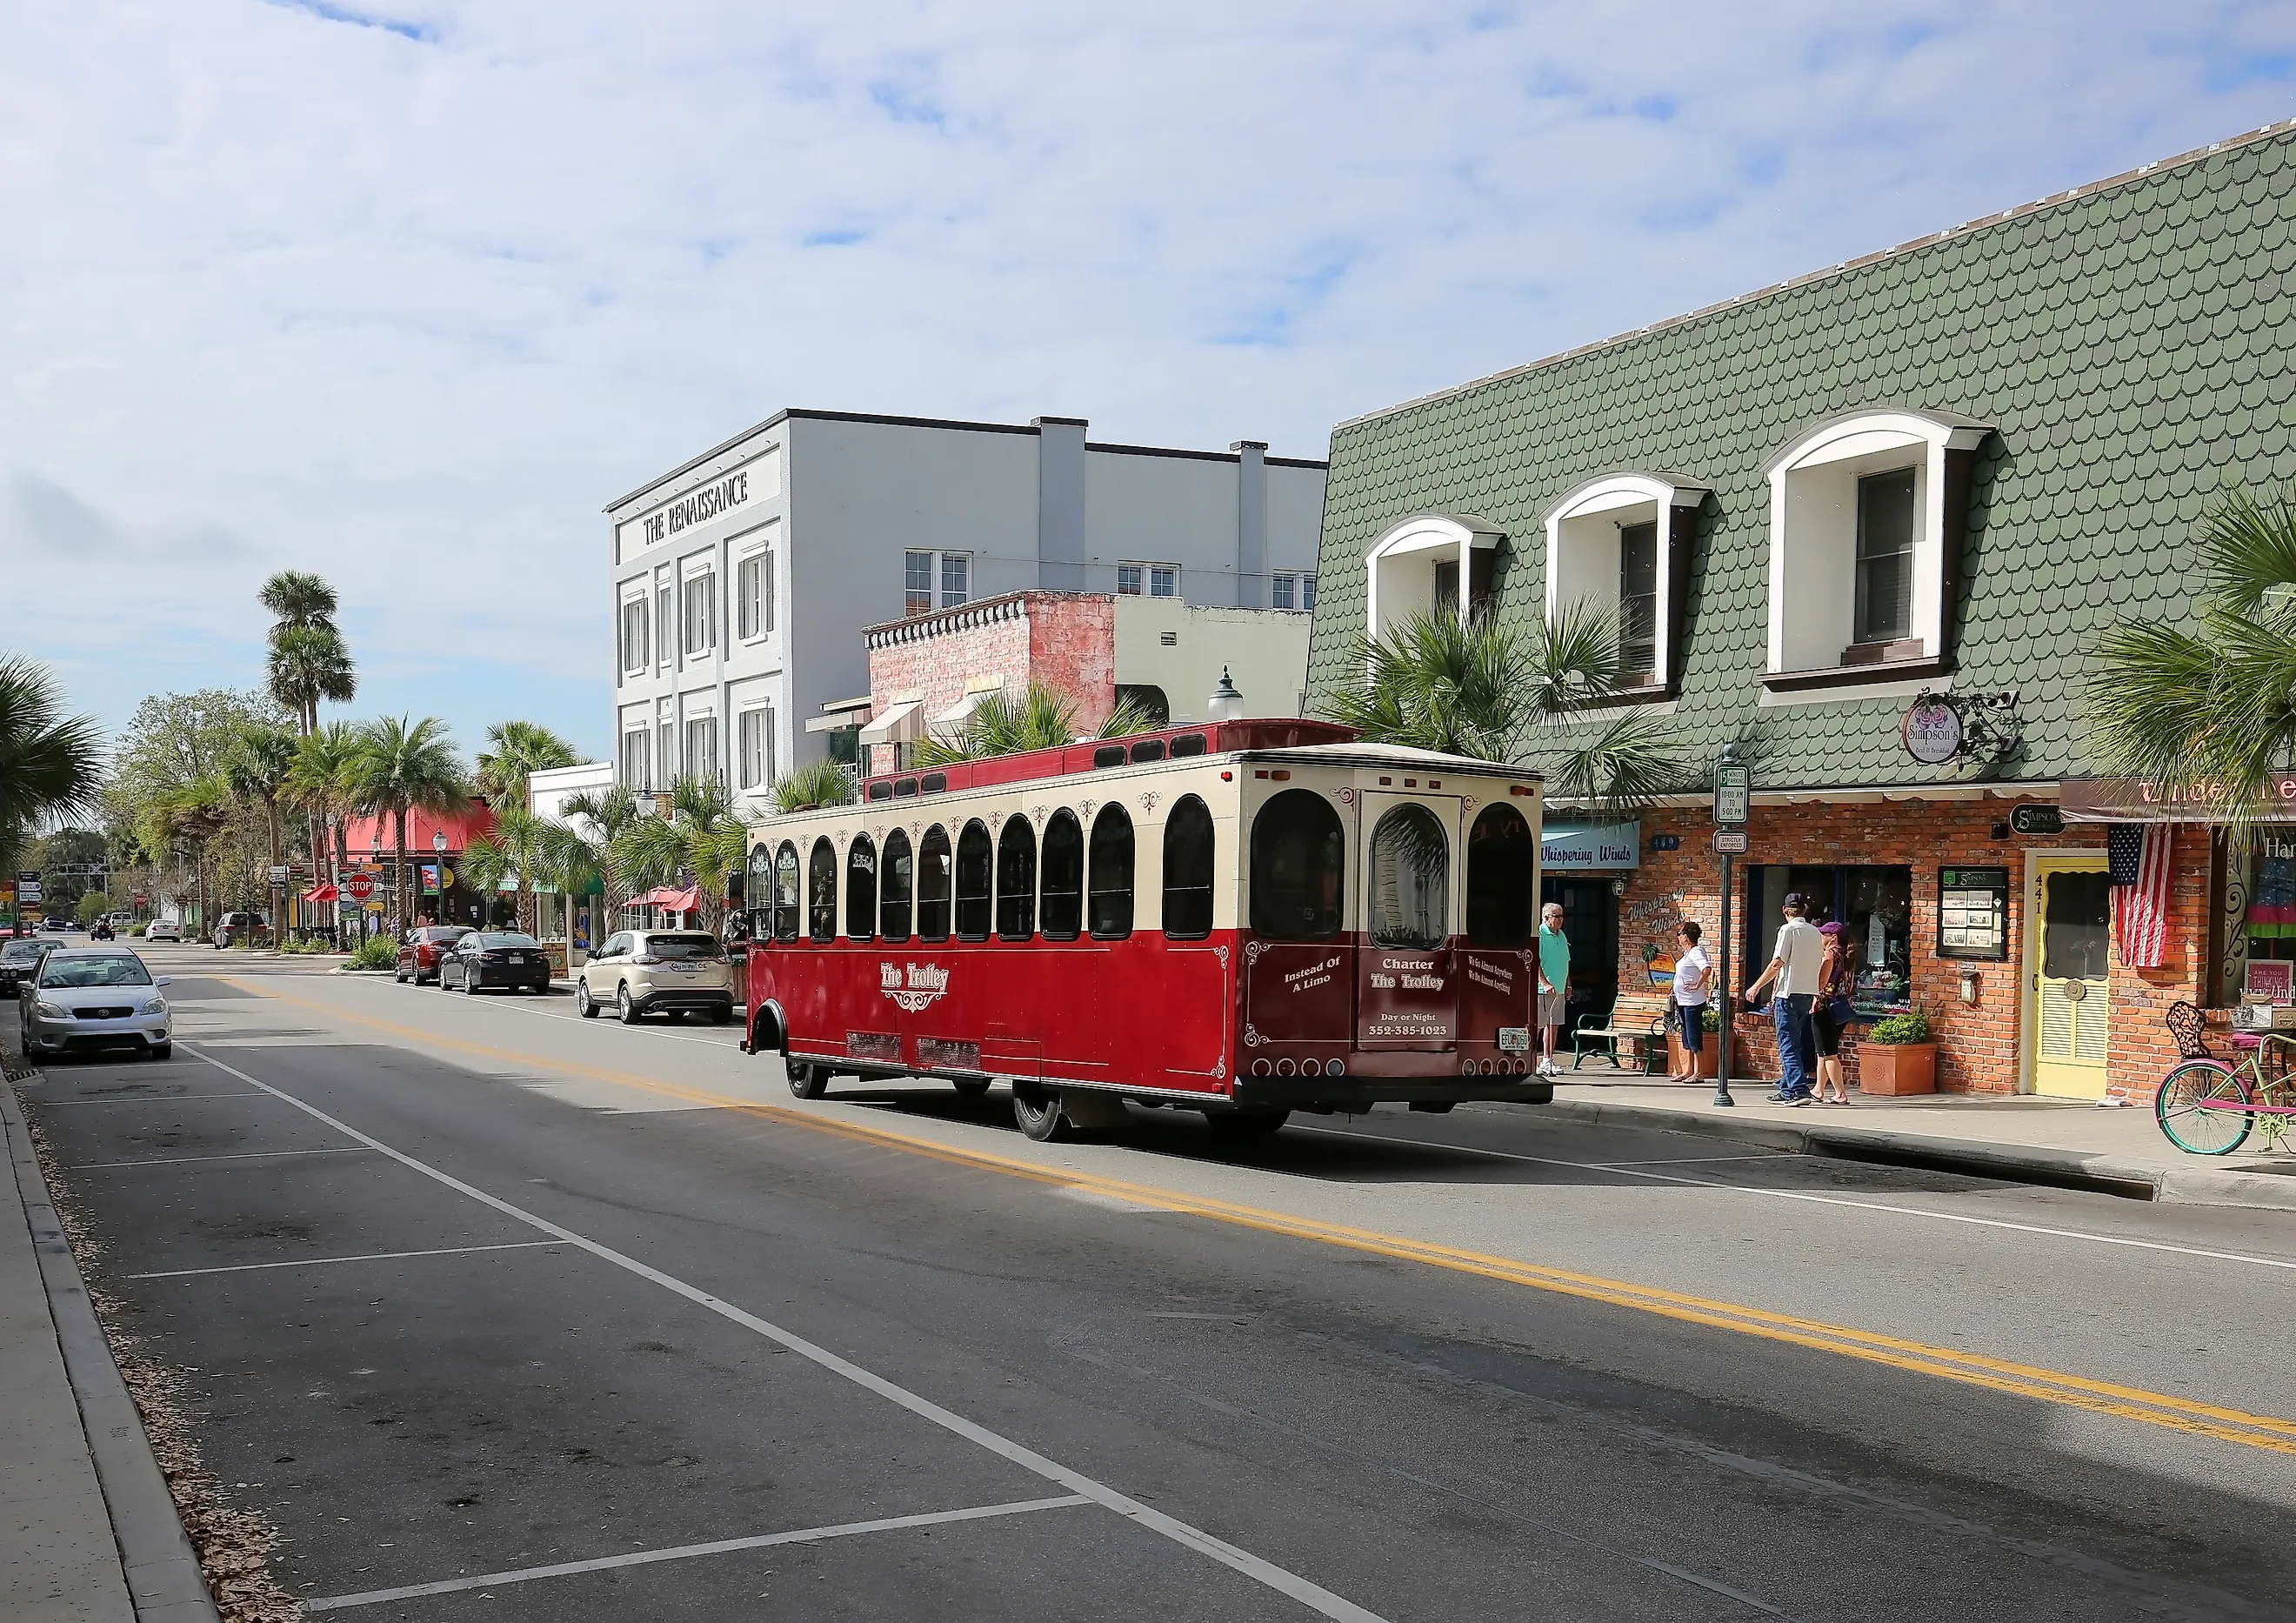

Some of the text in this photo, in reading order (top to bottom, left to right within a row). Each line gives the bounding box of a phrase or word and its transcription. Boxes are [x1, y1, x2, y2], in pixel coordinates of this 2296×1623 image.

[644, 471, 748, 545] THE RENAISSANCE
[1907, 725, 1958, 745] Simpson's
[1720, 771, 1727, 784] 15
[1599, 845, 1632, 862] Winds
[349, 881, 371, 891] STOP
[1627, 887, 1685, 922] Whispering
[1652, 909, 1685, 934] Winds
[1285, 956, 1340, 983] Instead Of
[1382, 958, 1434, 970] Charter
[880, 962, 949, 992] The Trolley
[1292, 975, 1331, 992] A Limo
[1371, 973, 1445, 991] The Trolley
[2253, 976, 2283, 988] THINKING
[1381, 1013, 1398, 1022] Day
[1412, 1013, 1436, 1022] Night
[1369, 1025, 1447, 1035] 352-385-1023
